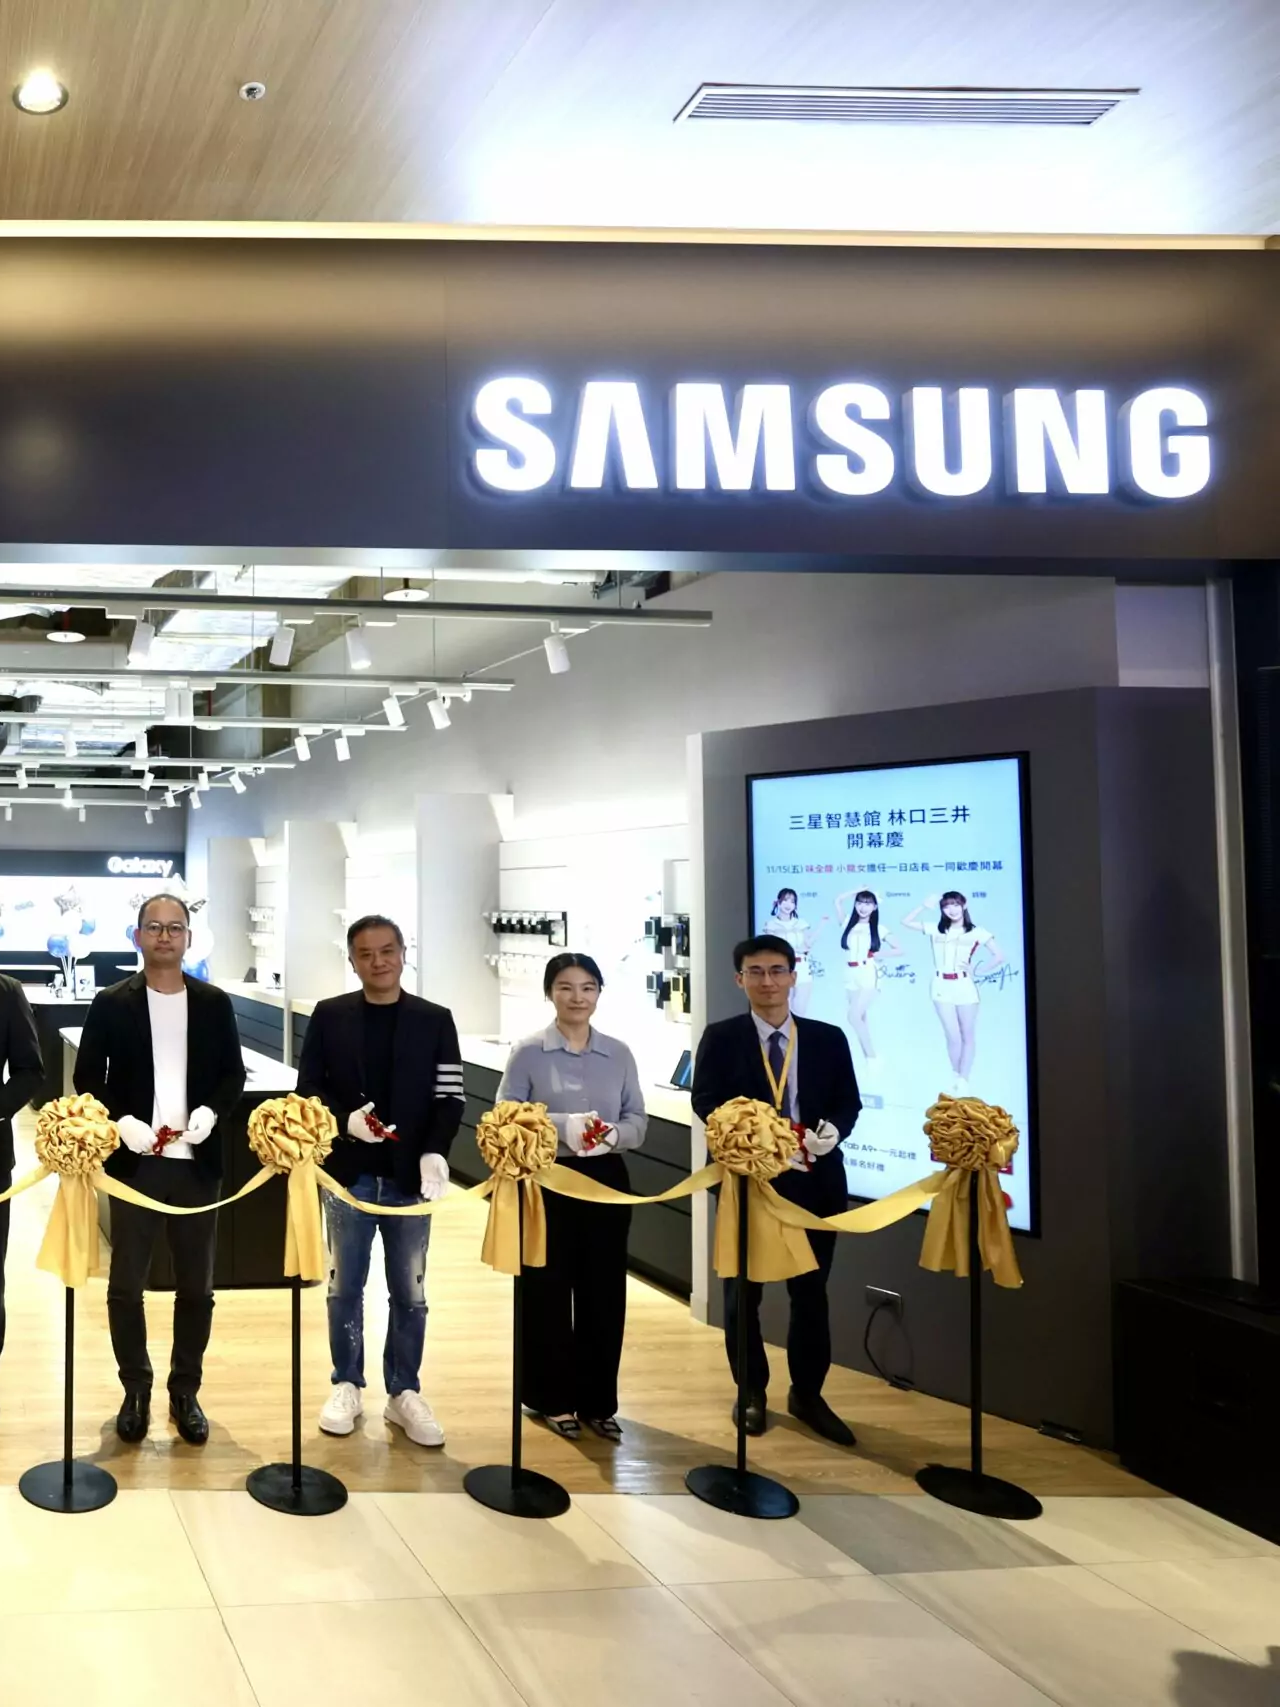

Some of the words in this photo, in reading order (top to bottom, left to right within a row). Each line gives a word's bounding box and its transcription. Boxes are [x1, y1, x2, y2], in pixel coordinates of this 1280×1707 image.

[473, 376, 1213, 499] SAMSUNG
[789, 810, 881, 831] 三星智慧館
[887, 805, 971, 825] 林口三井
[847, 831, 905, 849] 開幕慶
[107, 856, 174, 878] Galaxy
